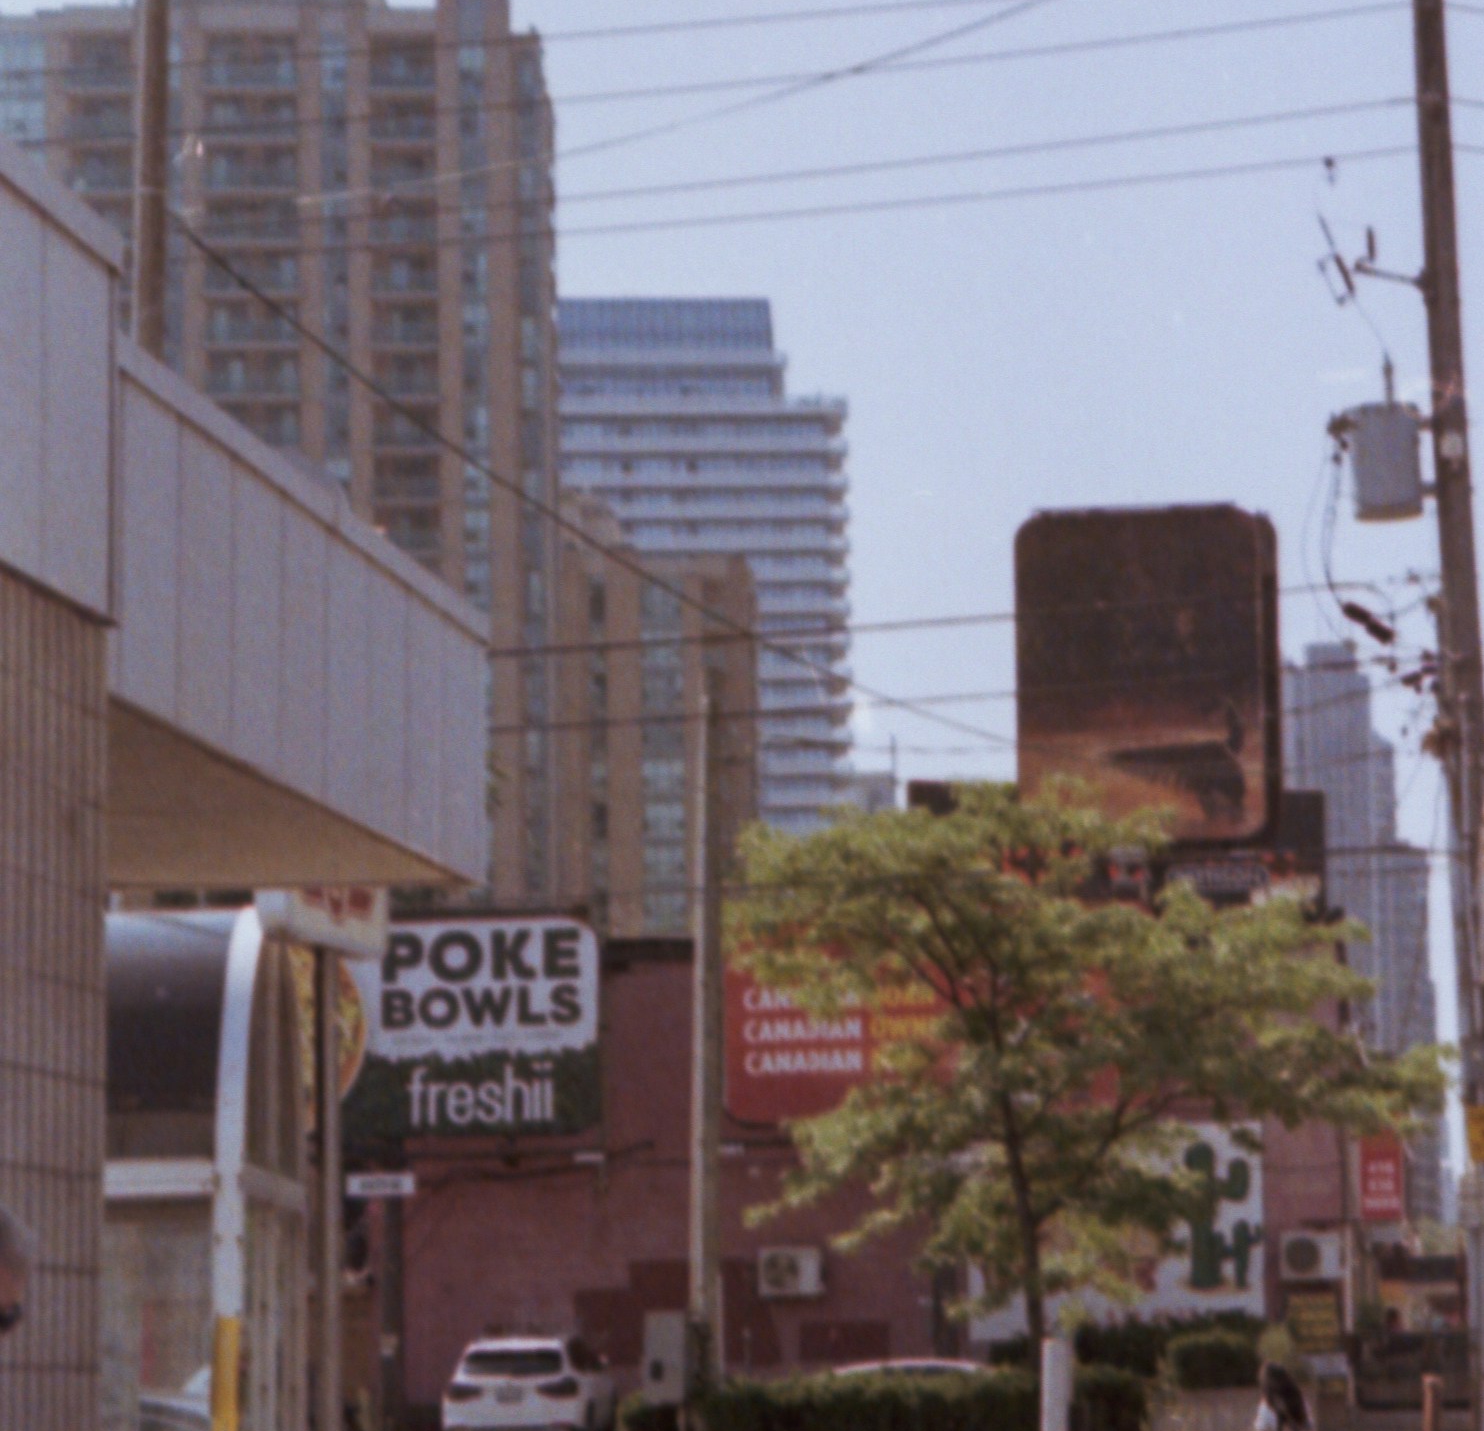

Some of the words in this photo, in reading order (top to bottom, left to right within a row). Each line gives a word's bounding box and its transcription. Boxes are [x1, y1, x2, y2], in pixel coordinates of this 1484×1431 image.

[382, 928, 581, 983] POKE
[382, 984, 581, 1029] BOWLS
[743, 1050, 863, 1076] CANADIAN
[407, 1062, 555, 1127] freshii
